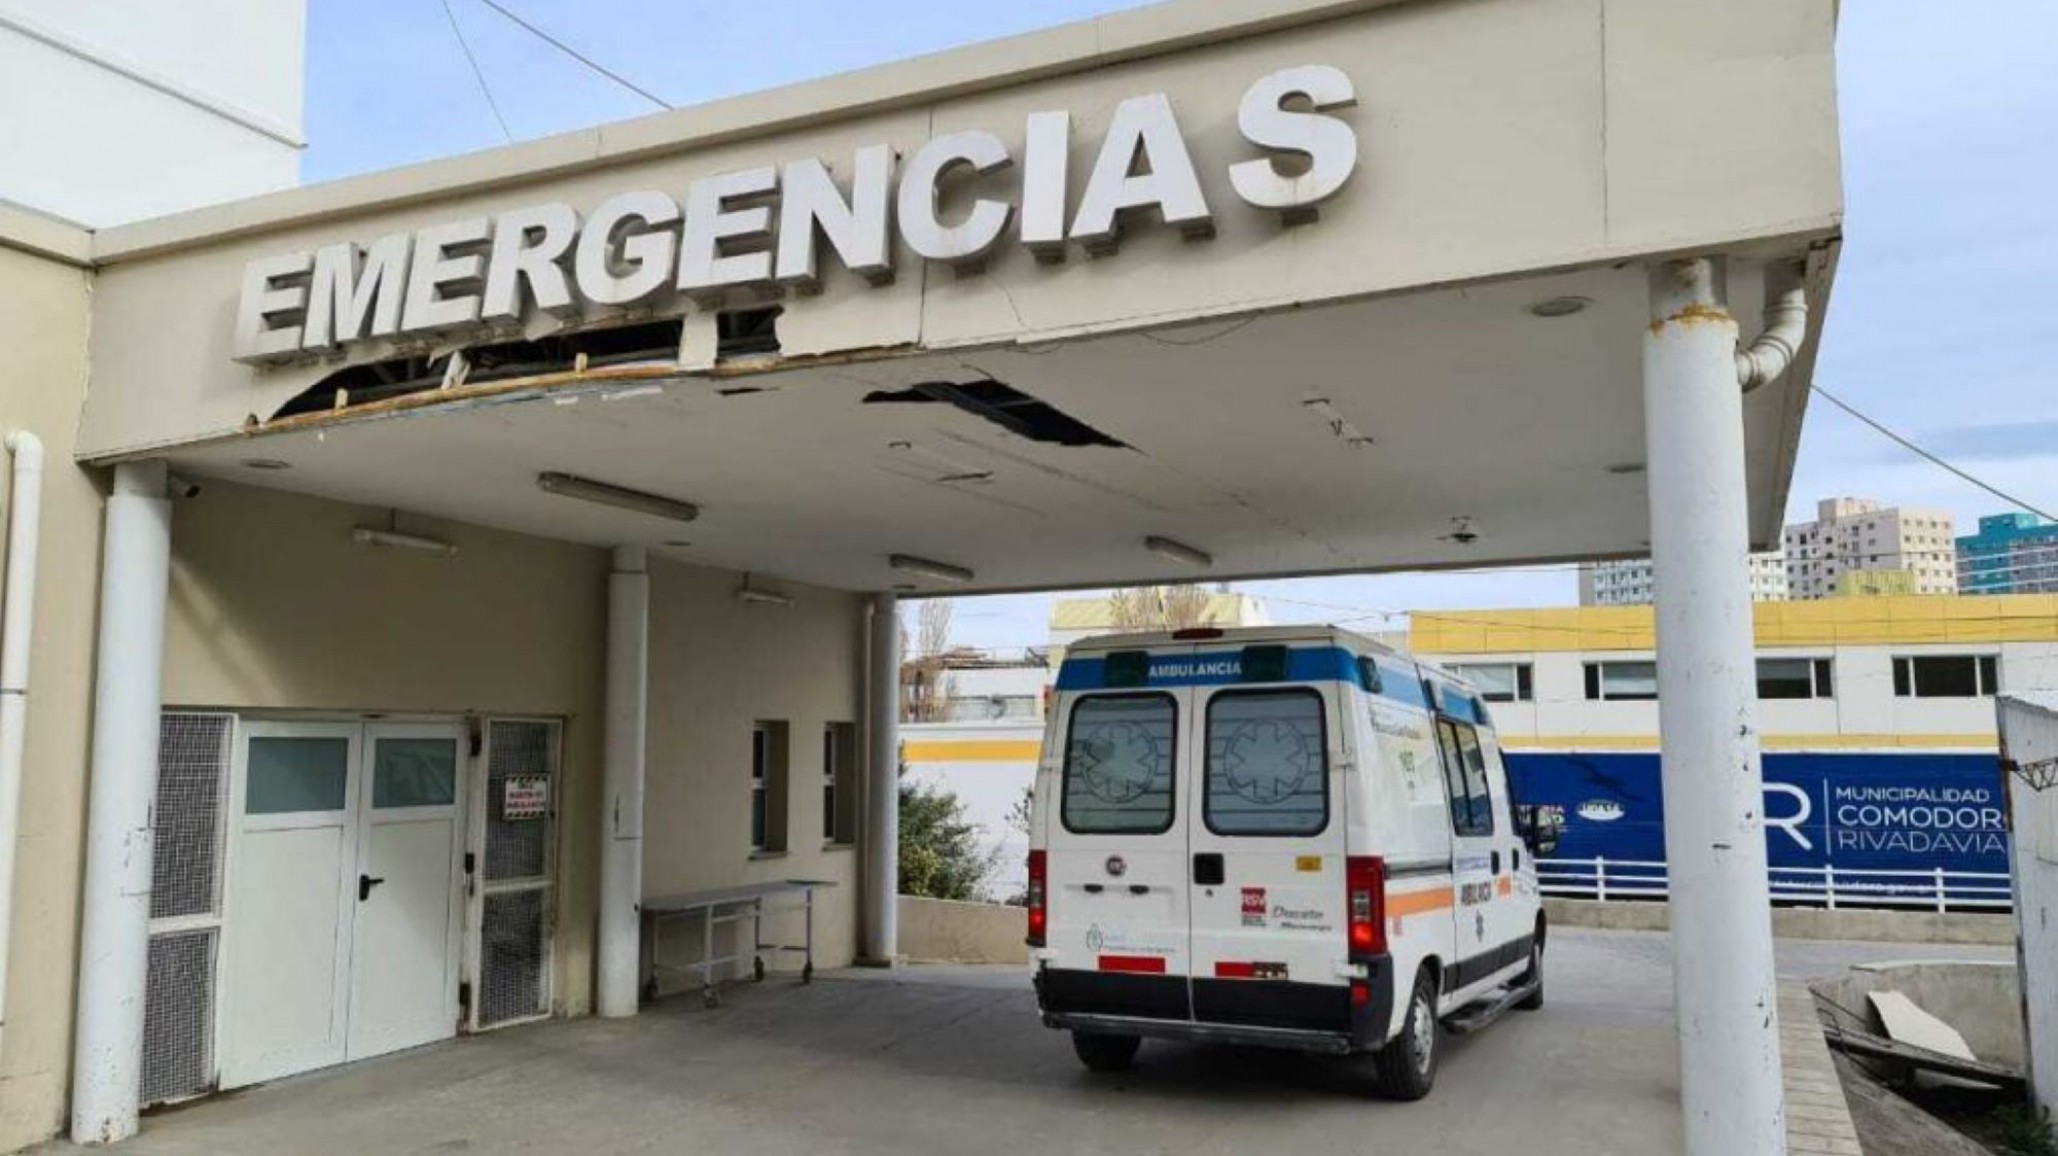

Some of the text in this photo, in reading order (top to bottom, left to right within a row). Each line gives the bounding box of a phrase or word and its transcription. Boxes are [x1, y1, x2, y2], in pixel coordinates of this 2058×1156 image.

[232, 64, 1358, 363] EMERGENCIAS
[1147, 661, 1243, 678] AMBULANCIA
[1836, 786, 1990, 803] MUNICIPALIDAD
[1838, 804, 2006, 829] COMODOR
[1839, 830, 2006, 854] RIVADAVIA
